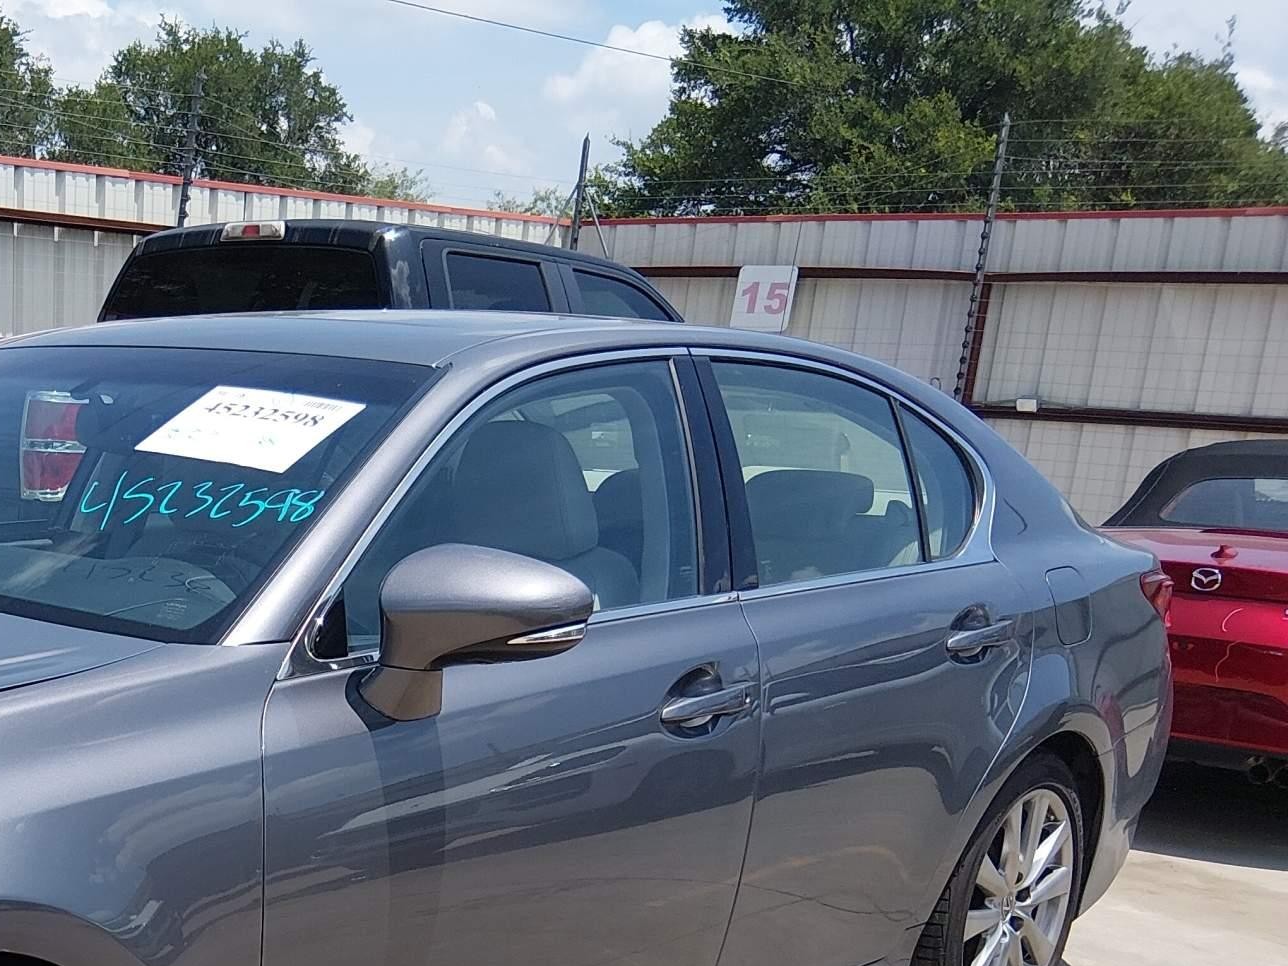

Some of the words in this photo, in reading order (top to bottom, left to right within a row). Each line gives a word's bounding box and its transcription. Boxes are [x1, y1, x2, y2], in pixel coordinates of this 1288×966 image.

[741, 281, 788, 315] 15
[204, 402, 325, 428] 45232598
[80, 470, 325, 531] 45232598
